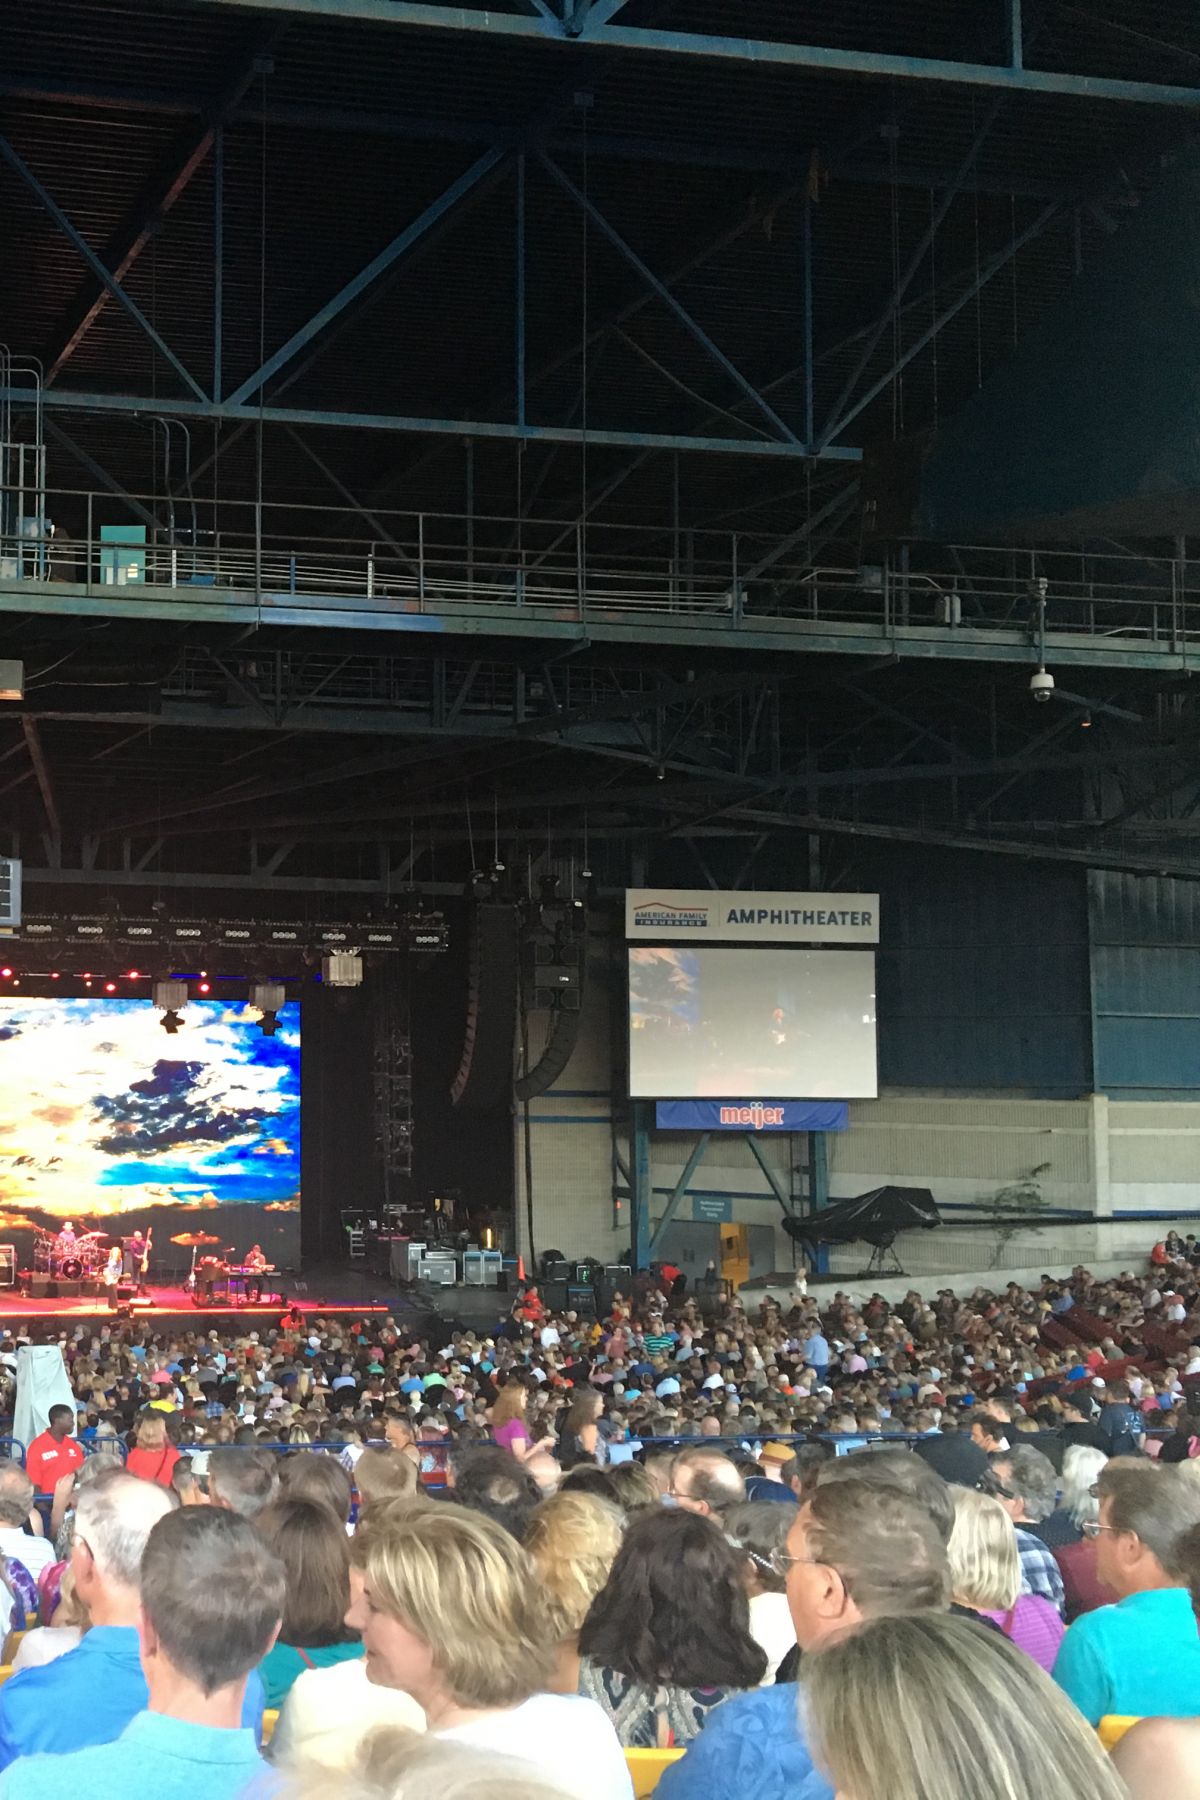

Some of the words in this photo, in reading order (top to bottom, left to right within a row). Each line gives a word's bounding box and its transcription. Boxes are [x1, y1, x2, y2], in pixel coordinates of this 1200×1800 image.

[635, 911, 676, 919] AMERICAN
[679, 912, 708, 920] FAMILY
[726, 908, 873, 926] AMPHITHEATER
[720, 1101, 785, 1130] meijer
